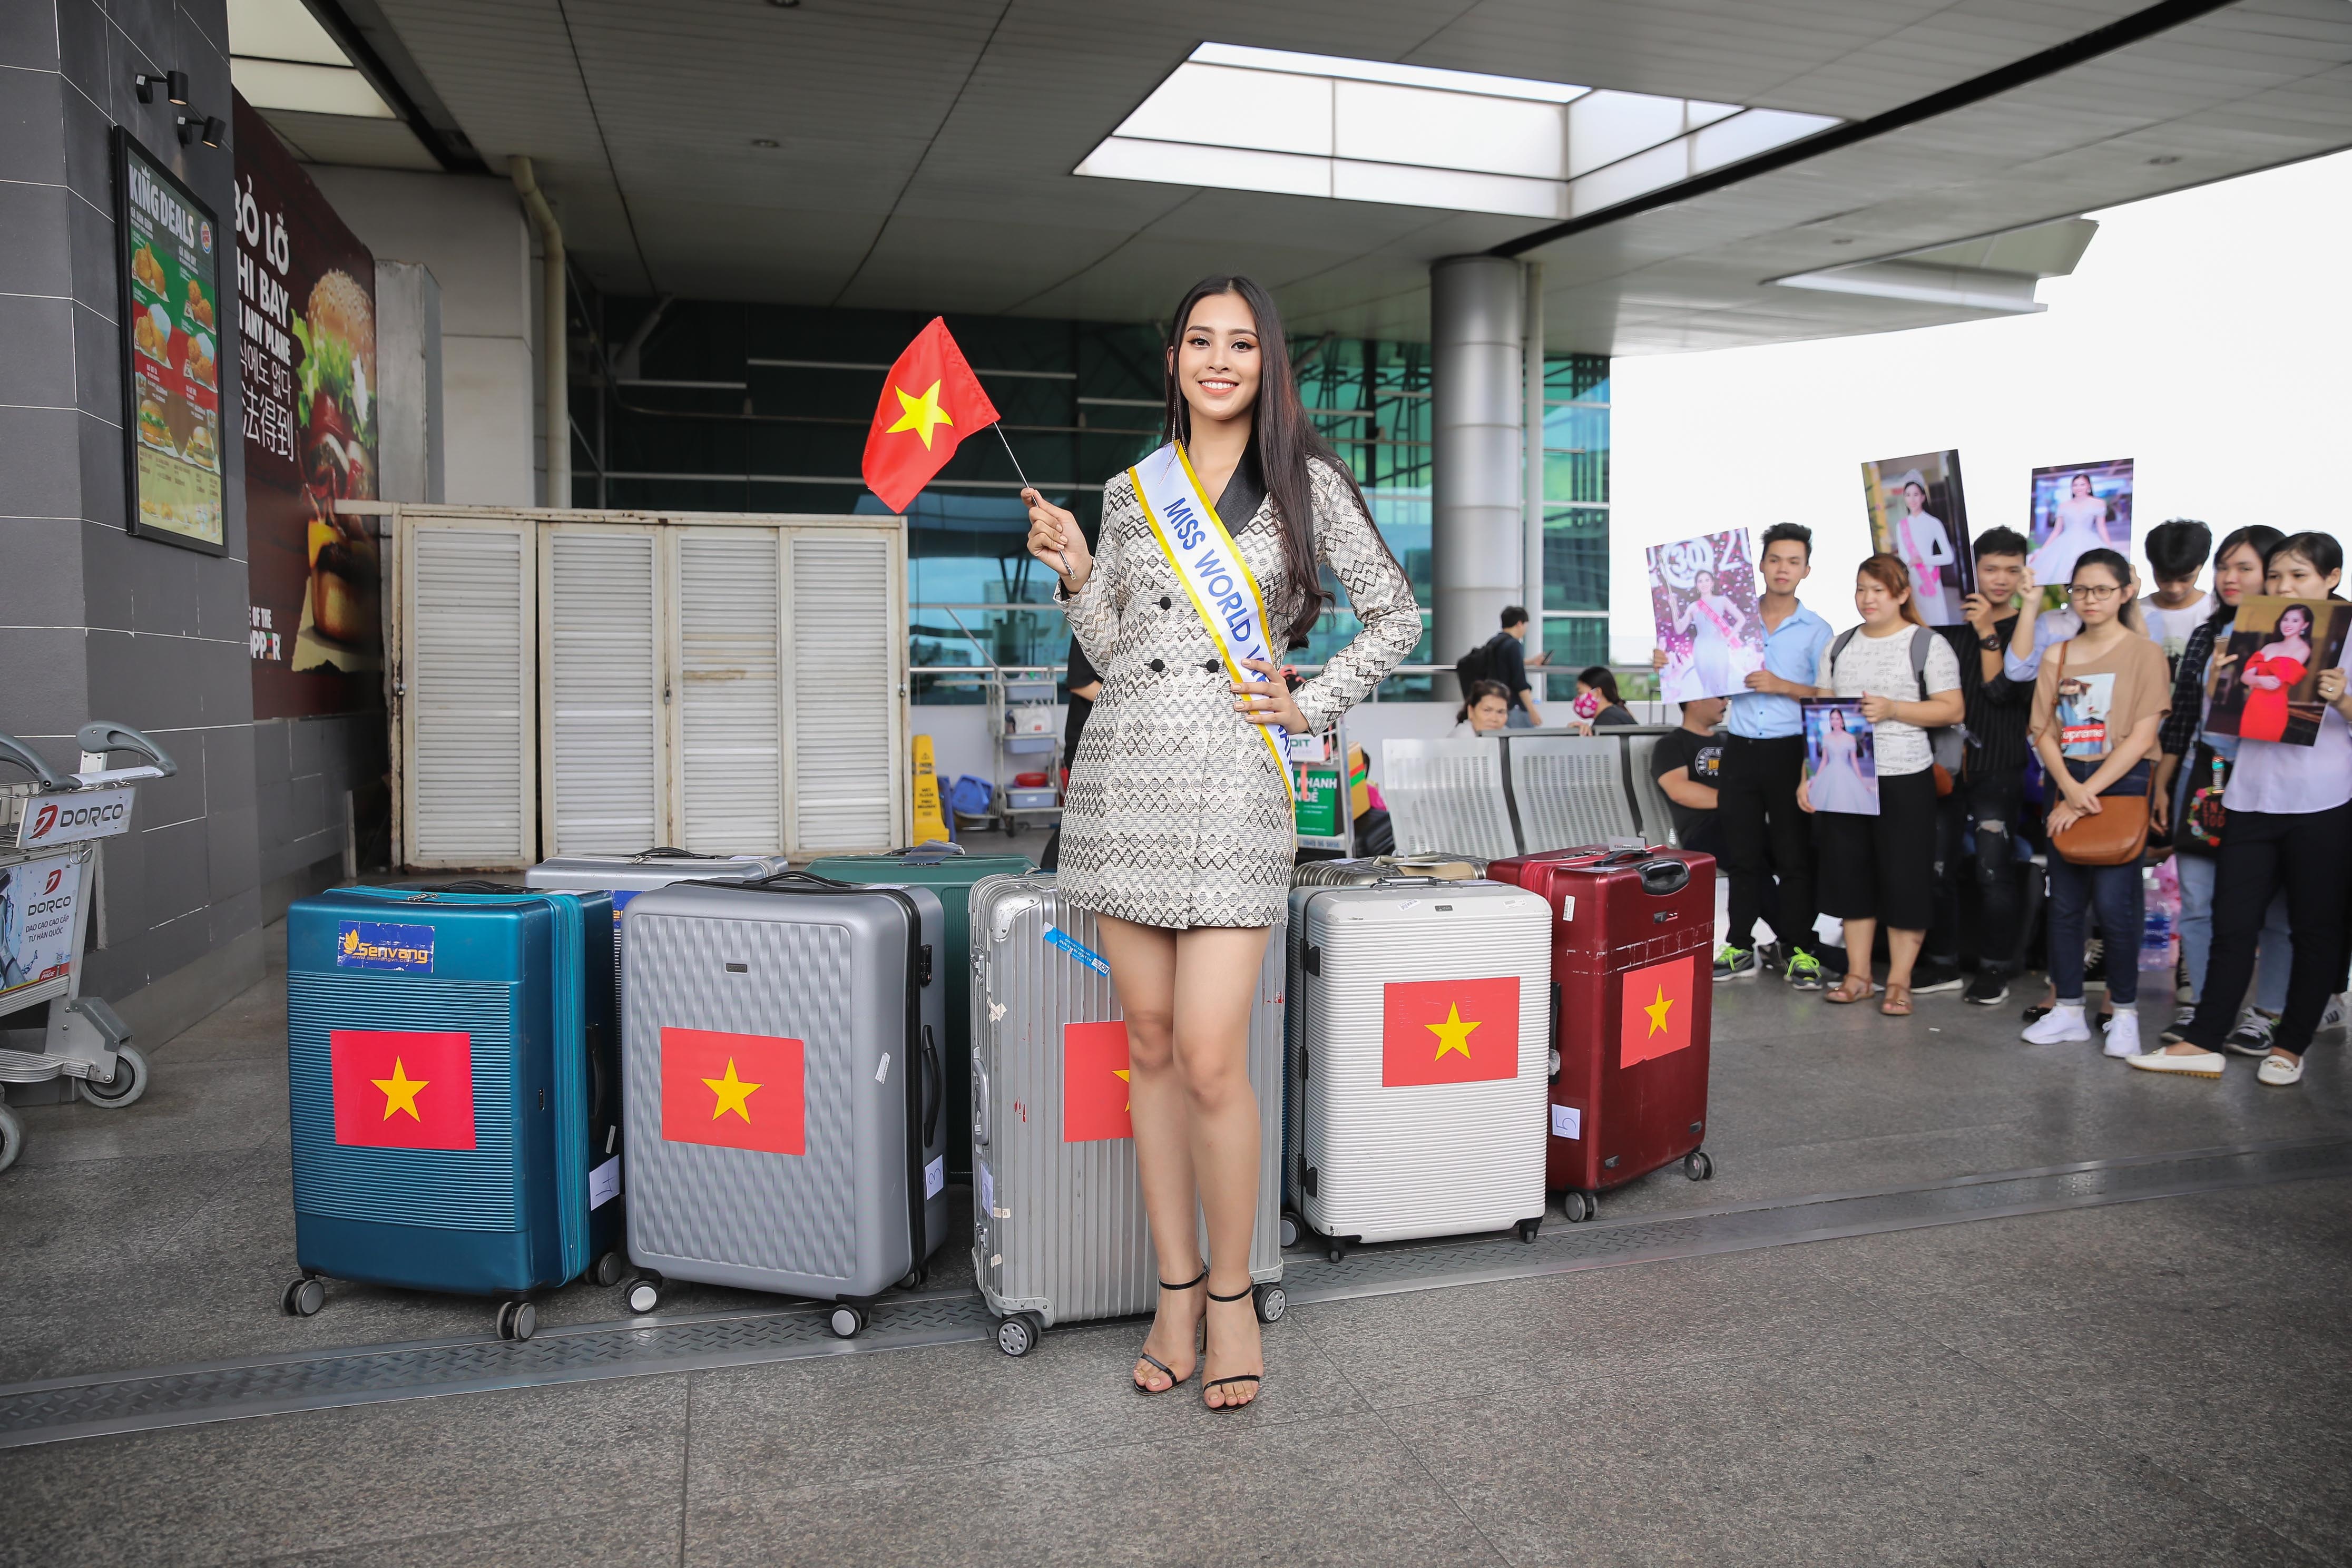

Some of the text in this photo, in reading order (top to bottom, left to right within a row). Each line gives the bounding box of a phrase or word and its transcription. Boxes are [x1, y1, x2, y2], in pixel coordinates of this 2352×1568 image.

[129, 164, 194, 249] KING DEALS
[260, 267, 289, 328] BAY
[245, 305, 263, 345] ANY
[265, 320, 291, 366] PLANE
[1163, 497, 1251, 642] MISS WORLD
[60, 803, 124, 828] DORCO
[28, 896, 71, 916] DORCO
[25, 913, 70, 933] DAO CẠO CAO CẤP
[37, 930, 48, 940] HÀN
[48, 926, 63, 937] QUỐC
[352, 943, 429, 964] Senvang
